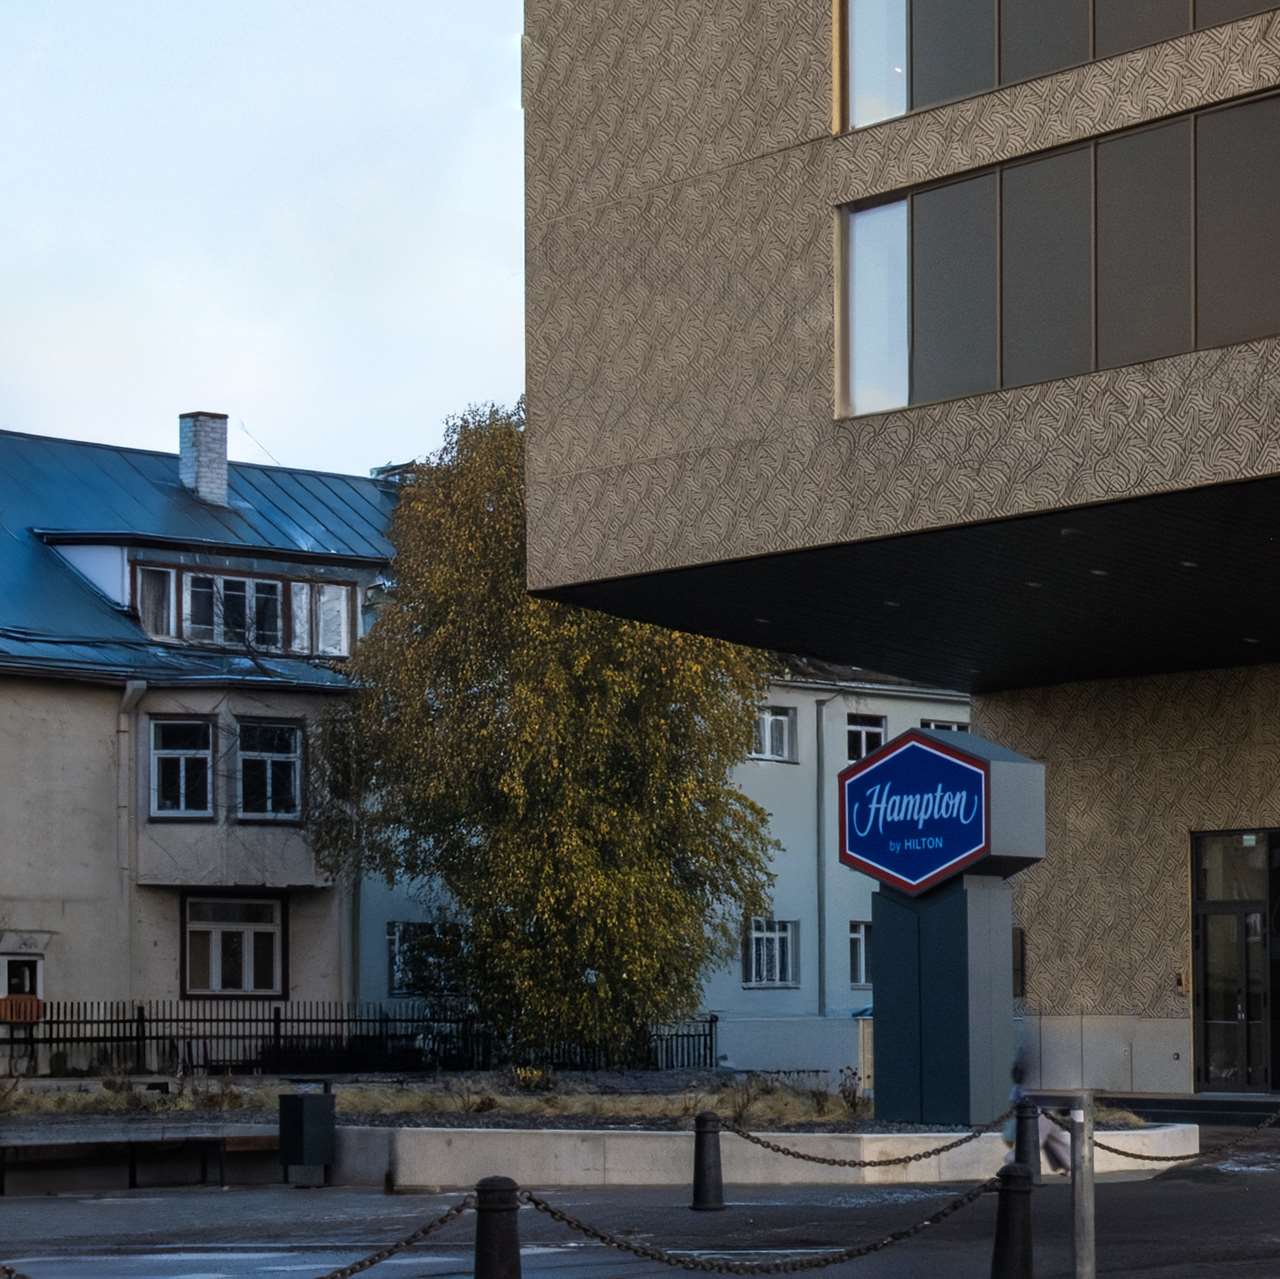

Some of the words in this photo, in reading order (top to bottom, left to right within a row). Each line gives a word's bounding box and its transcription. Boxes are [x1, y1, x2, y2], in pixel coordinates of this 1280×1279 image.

[853, 781, 978, 837] Hampton
[889, 840, 902, 854] by
[904, 836, 944, 850] HILTON
